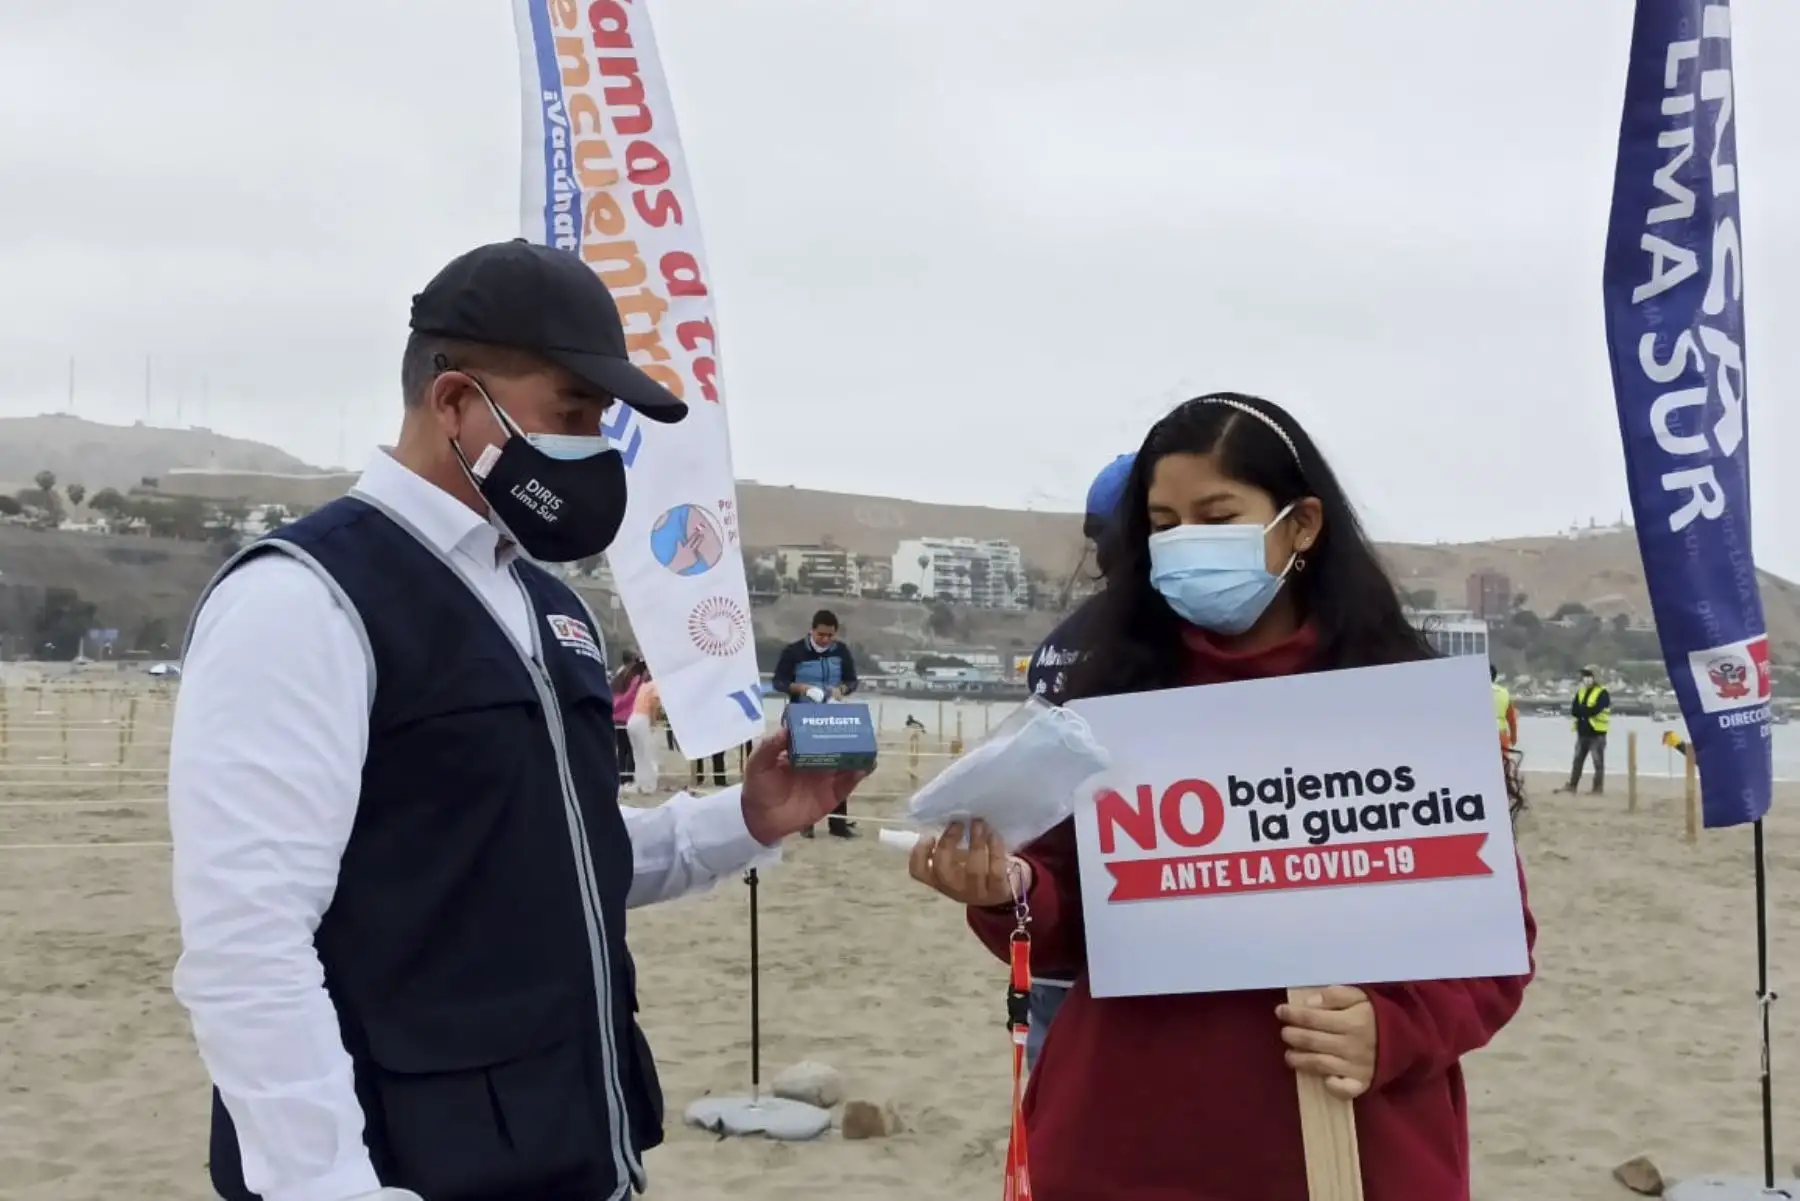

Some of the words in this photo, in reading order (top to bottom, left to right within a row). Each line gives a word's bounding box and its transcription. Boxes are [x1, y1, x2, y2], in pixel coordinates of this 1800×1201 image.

[543, 90, 577, 252] ¡Vacúnat
[587, 0, 682, 227] amos
[659, 251, 708, 297] a
[1632, 39, 1700, 304] LIMA
[1639, 328, 1725, 533] SUR
[510, 484, 538, 511] Lima
[536, 504, 559, 522] Sur
[525, 478, 563, 510] DIRIS
[802, 716, 861, 725] PROTÉGETE
[1094, 778, 1224, 854] NO
[1227, 764, 1416, 809] bajemos
[1248, 808, 1289, 842] la
[1302, 787, 1485, 845] guardia
[1160, 860, 1229, 891] ANTE
[1240, 857, 1276, 886] LA
[1285, 846, 1415, 881] COVID-19
